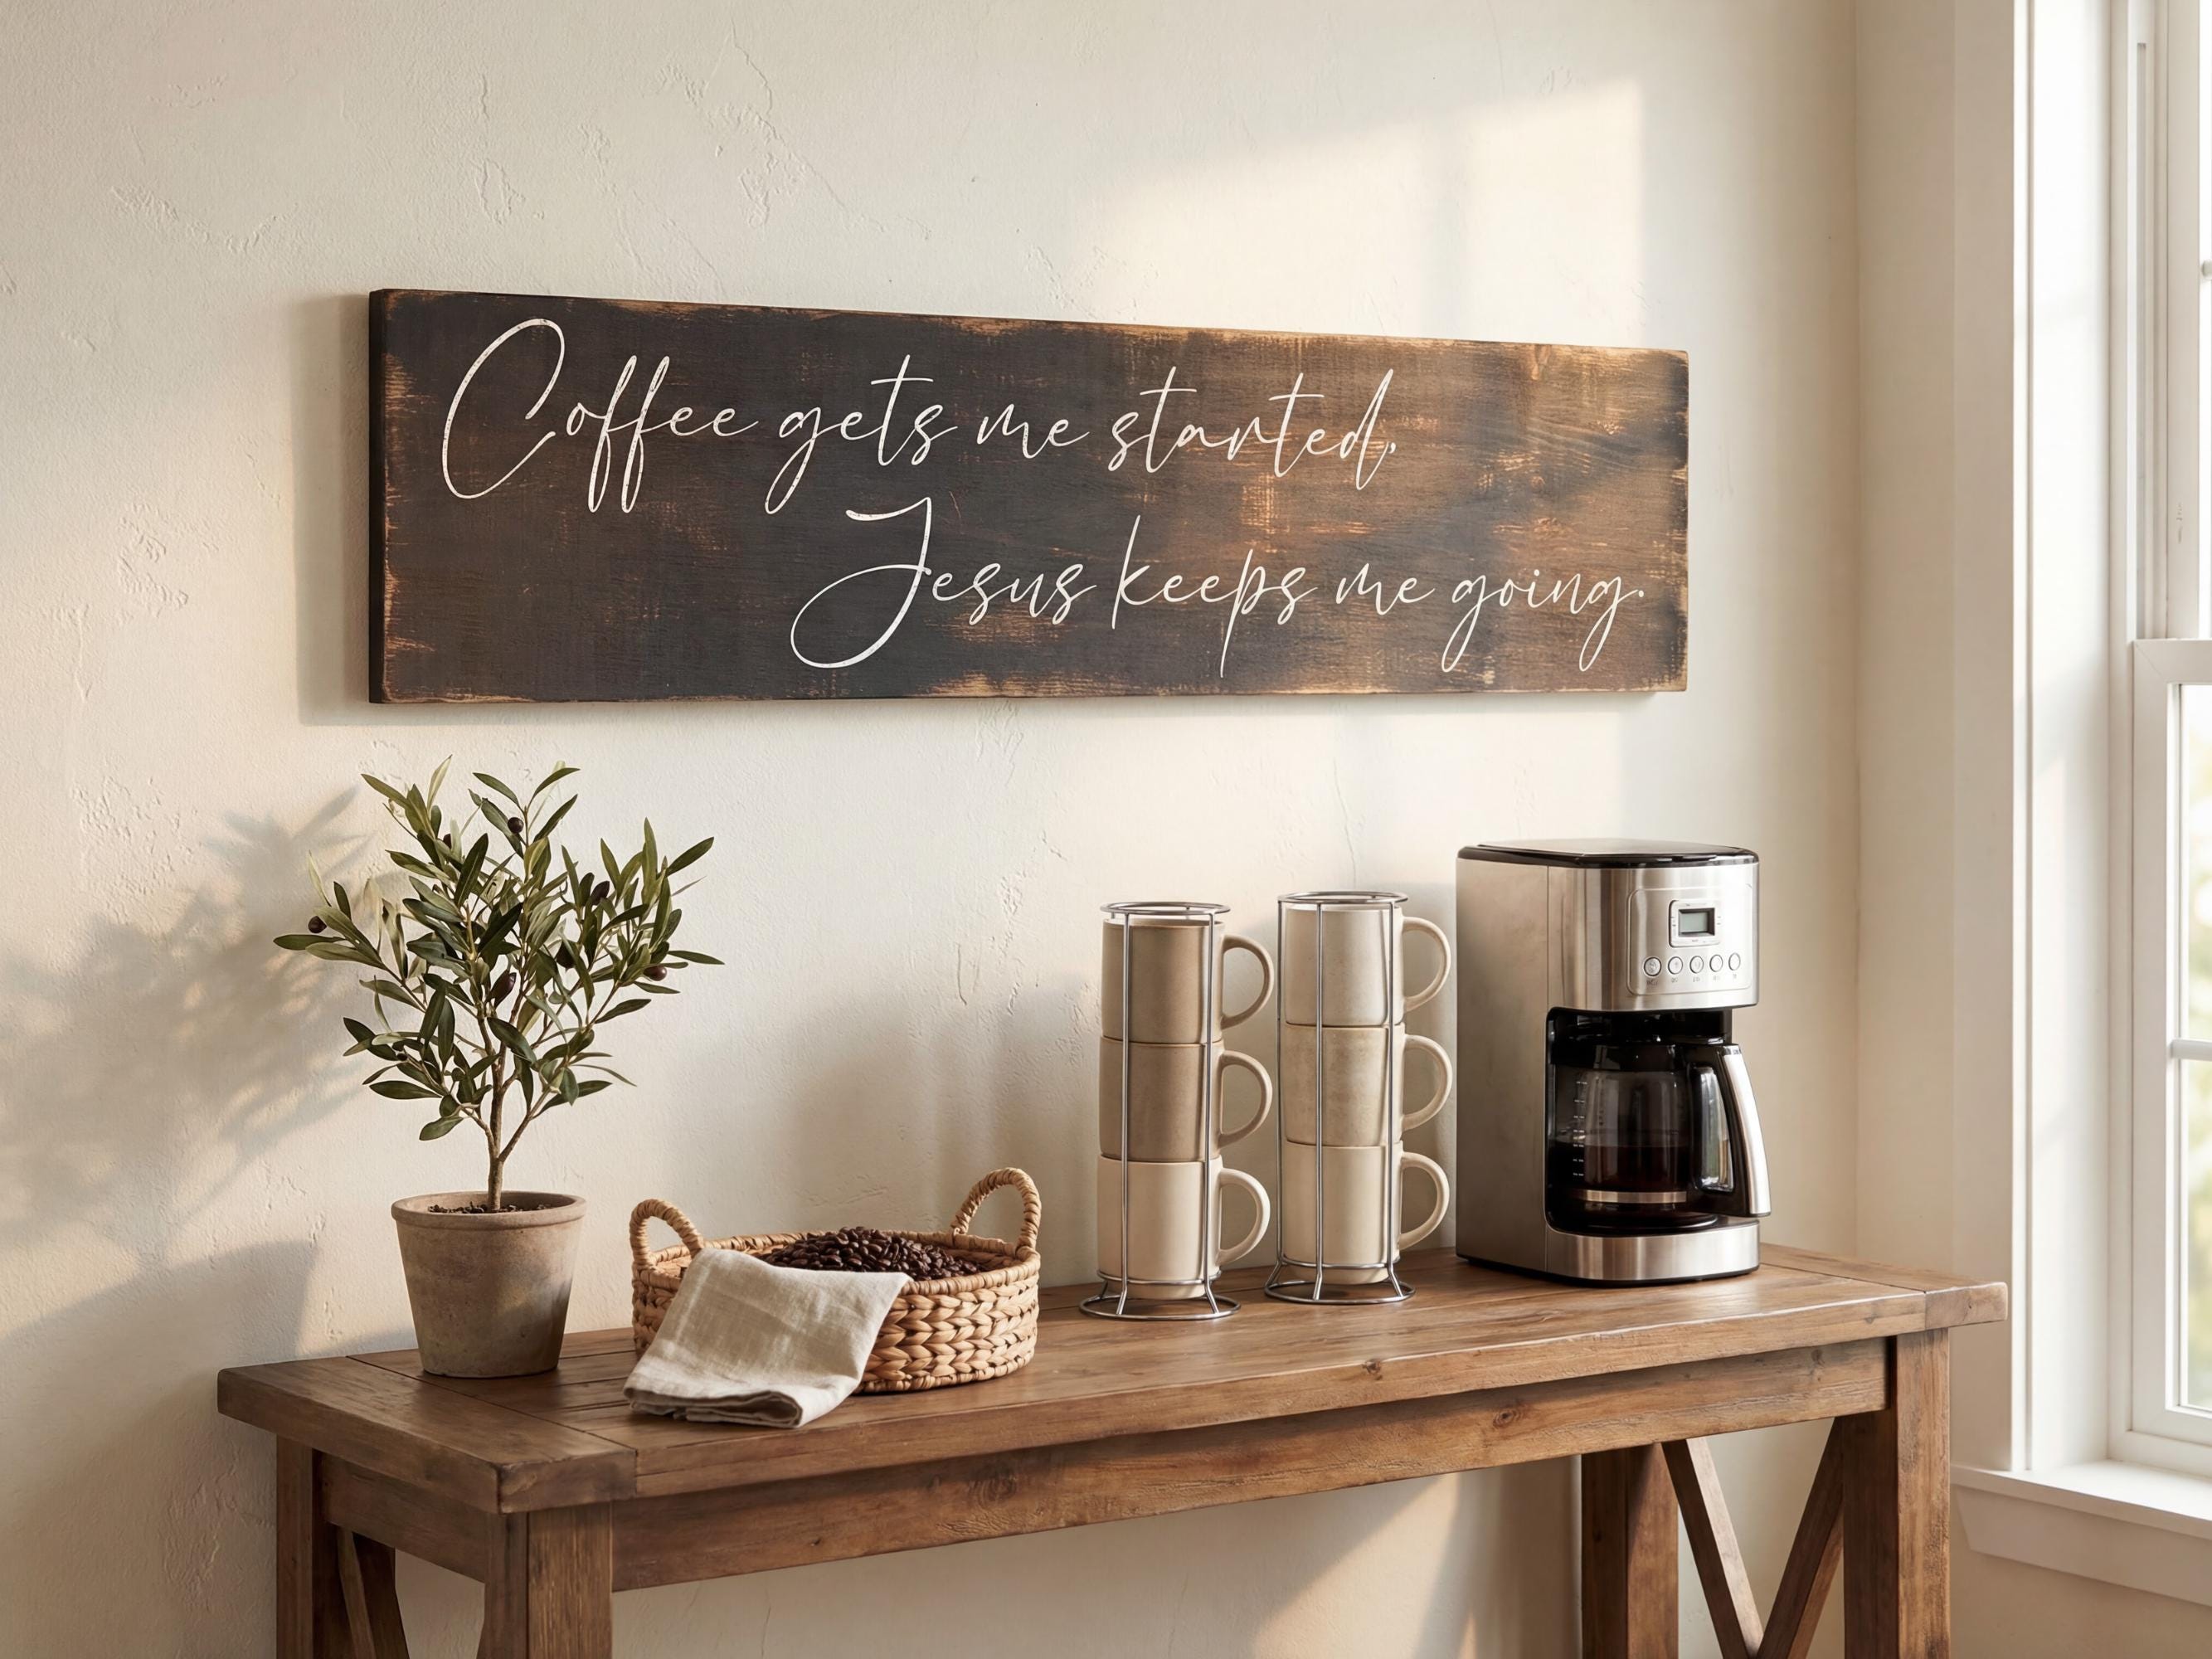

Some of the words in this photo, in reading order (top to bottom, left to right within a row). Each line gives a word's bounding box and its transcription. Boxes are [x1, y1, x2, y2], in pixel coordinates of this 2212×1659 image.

[442, 318, 760, 514] Coffee
[765, 354, 959, 515] gets
[975, 402, 1091, 460] me
[790, 497, 1098, 669] Jesus
[1111, 513, 1319, 679] keeps
[1334, 562, 1437, 615] me
[1440, 568, 1646, 674] going.
